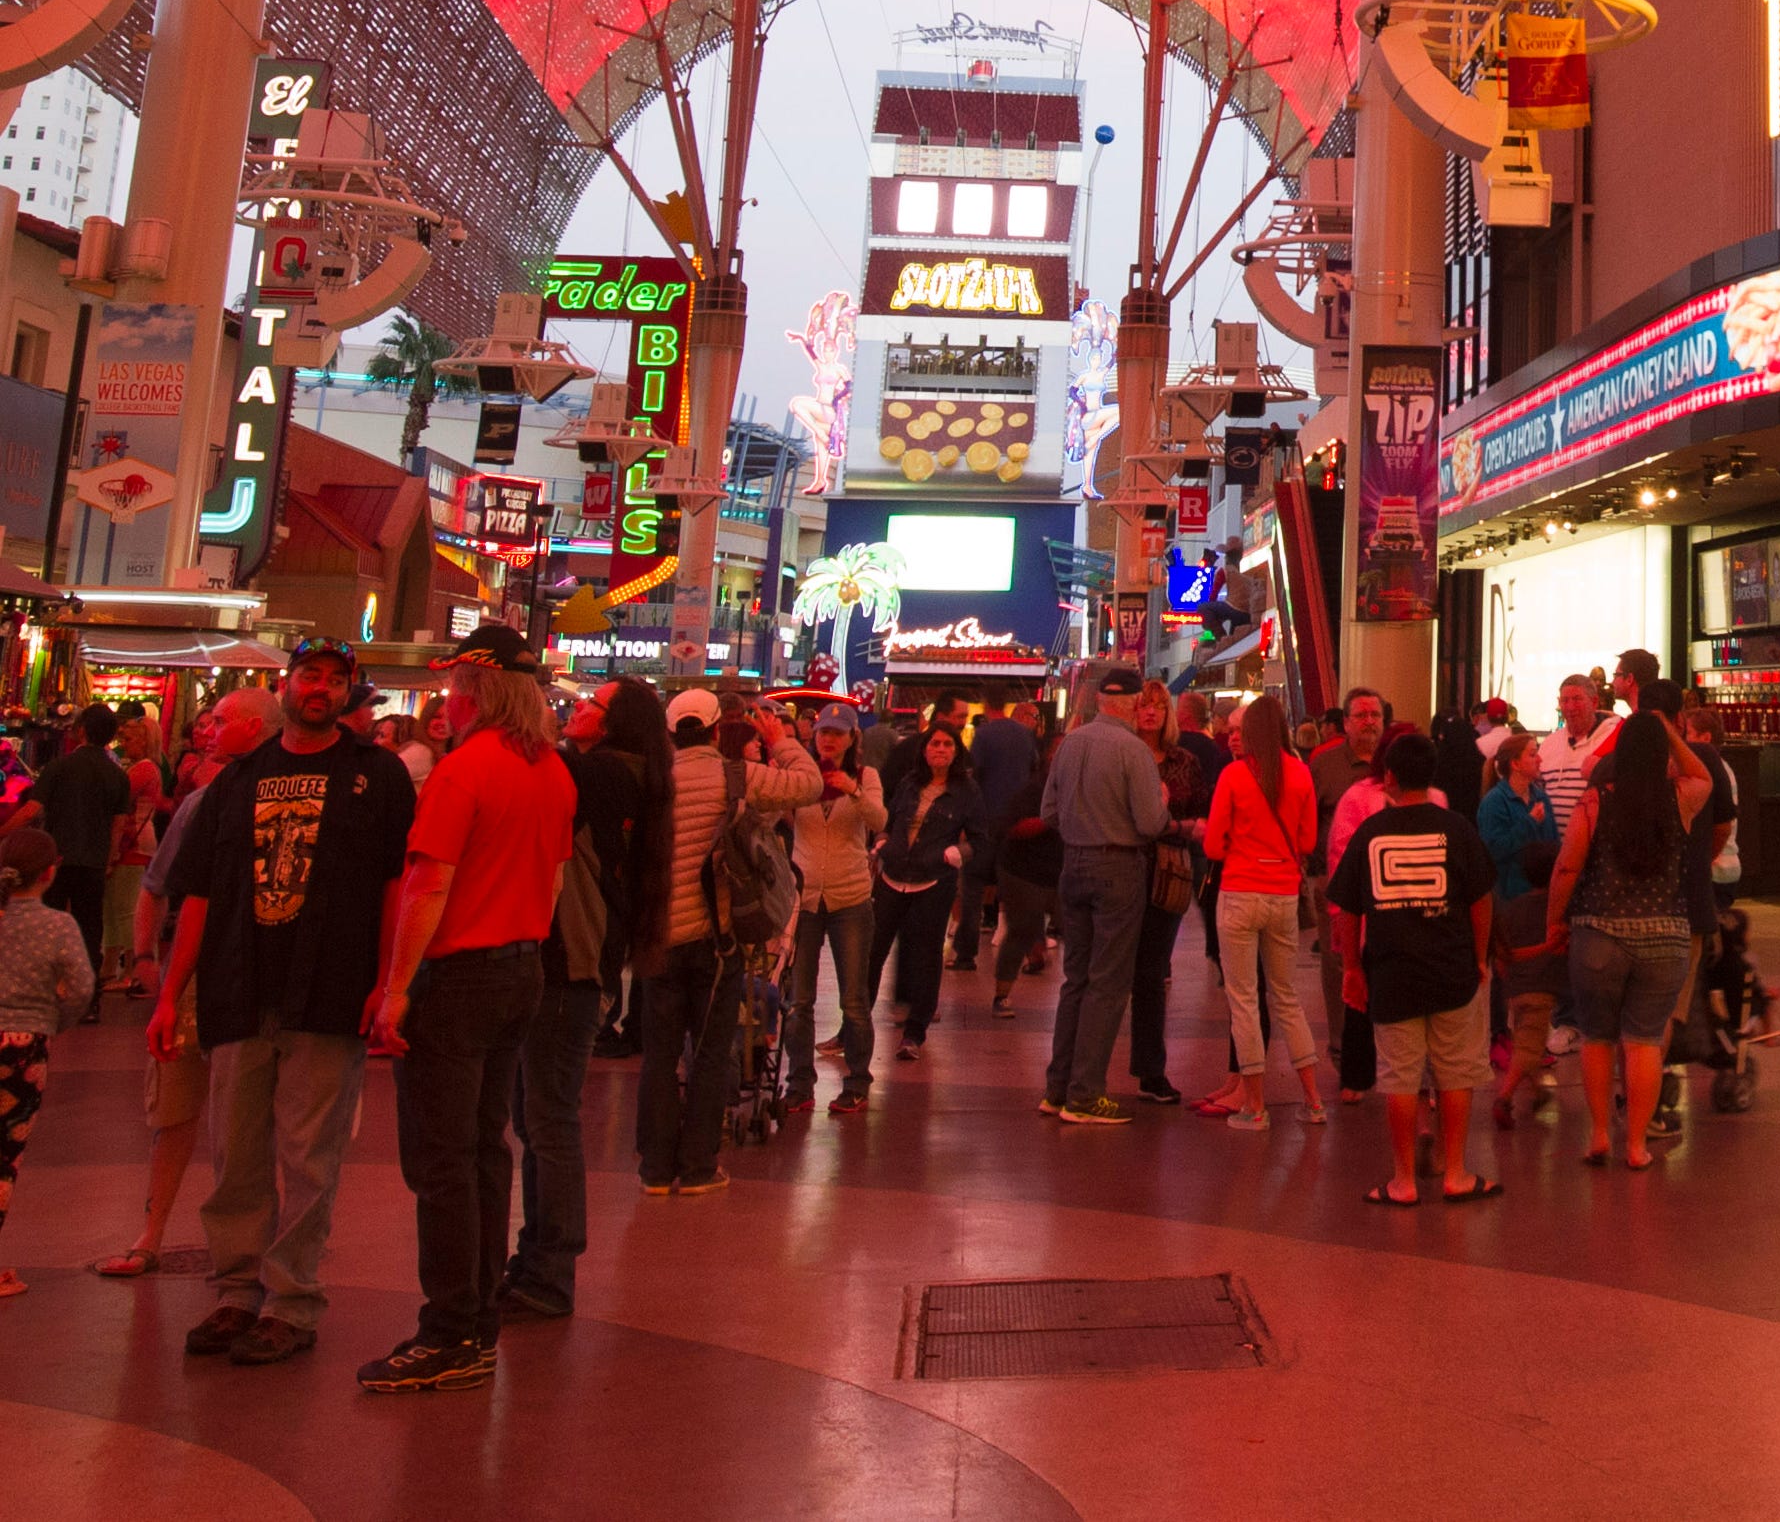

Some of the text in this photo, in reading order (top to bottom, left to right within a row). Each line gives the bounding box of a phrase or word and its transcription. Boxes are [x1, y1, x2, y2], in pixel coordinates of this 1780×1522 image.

[260, 74, 314, 117] El
[889, 257, 1044, 315] SLOTZILLA
[101, 363, 186, 382] LAS VEGAS
[1566, 329, 1718, 438] AMERICAN CONEY ISLAND
[96, 382, 184, 403] WELCOMES
[1484, 414, 1547, 473] OPEN 24 HOURS
[1180, 497, 1203, 518] R
[484, 508, 528, 537] PIZZA
[126, 563, 155, 574] HOST
[1119, 610, 1148, 629] FLY
